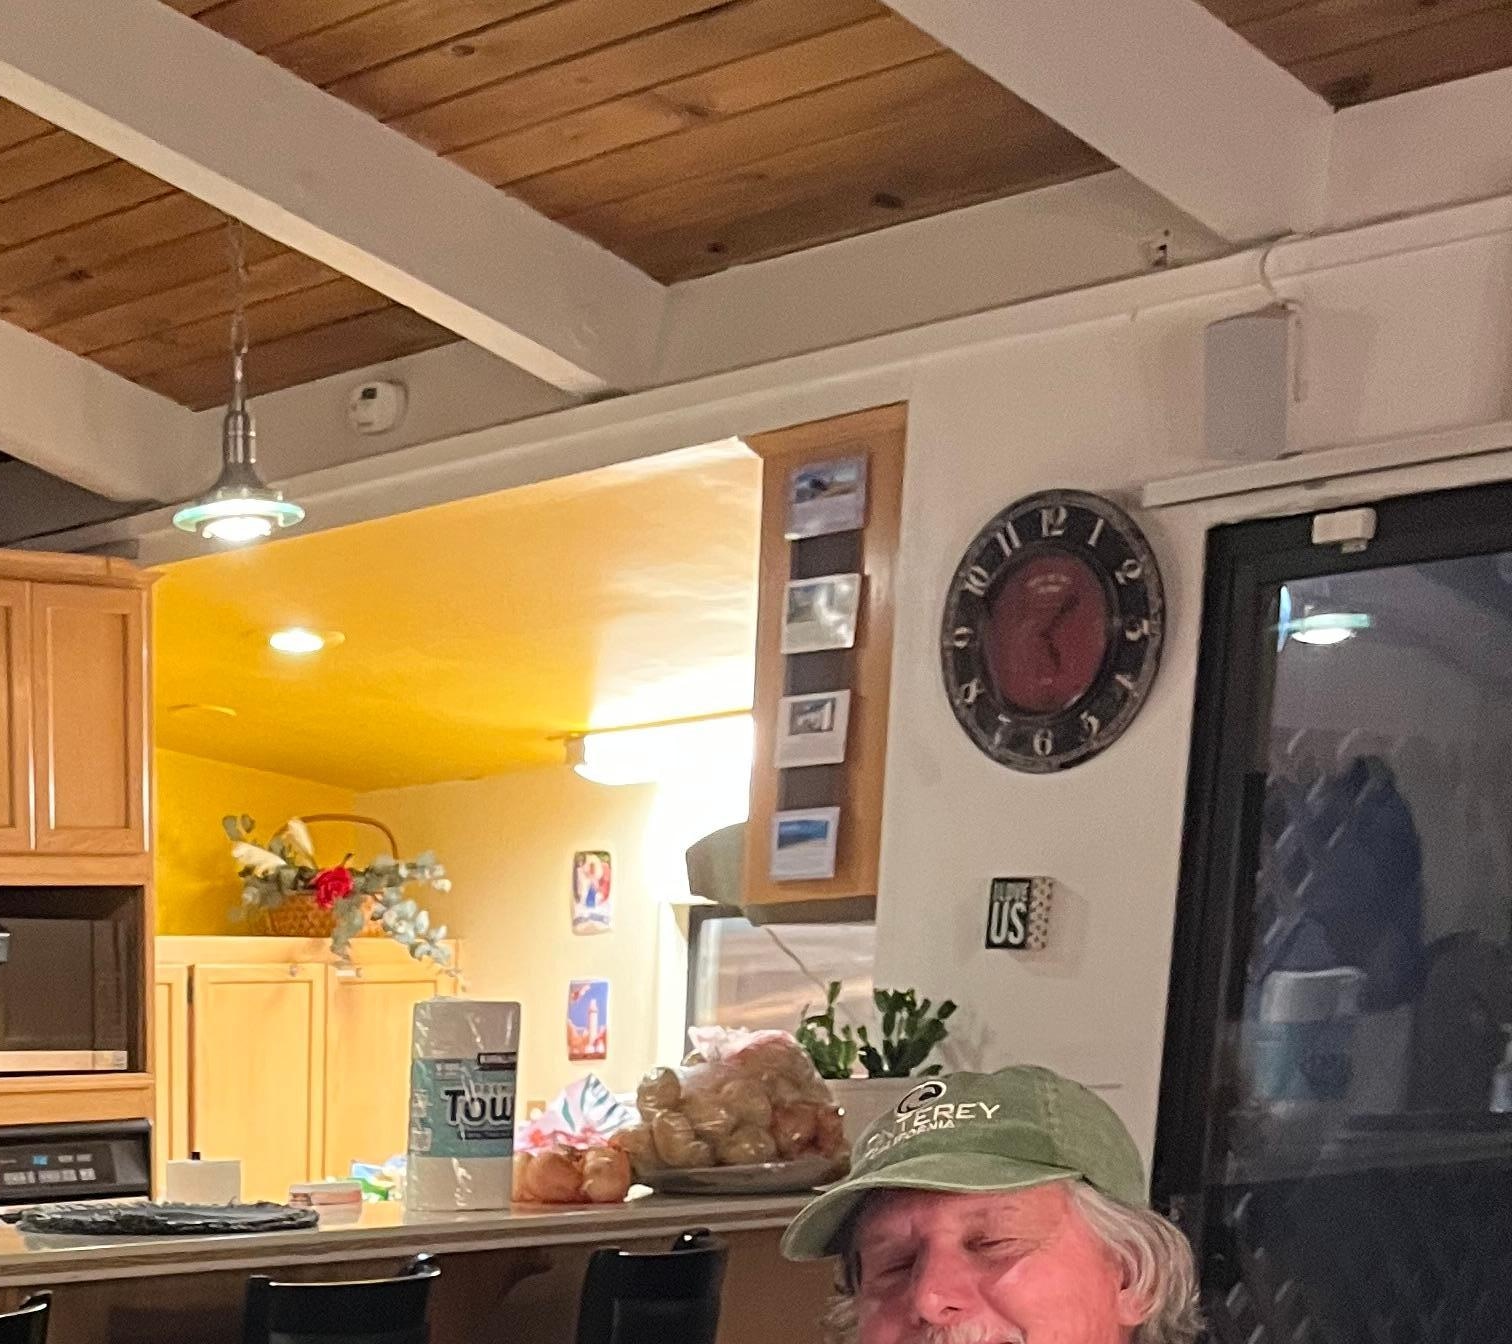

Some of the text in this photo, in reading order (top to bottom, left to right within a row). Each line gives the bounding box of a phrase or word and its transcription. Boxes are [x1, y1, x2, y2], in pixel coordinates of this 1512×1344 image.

[1041, 507, 1067, 537] 12
[1088, 519, 1103, 547] 1
[996, 521, 1023, 557] 11
[963, 566, 989, 596] 10
[1115, 559, 1141, 584] 2
[1033, 728, 1053, 755] 6
[990, 901, 1027, 944] US
